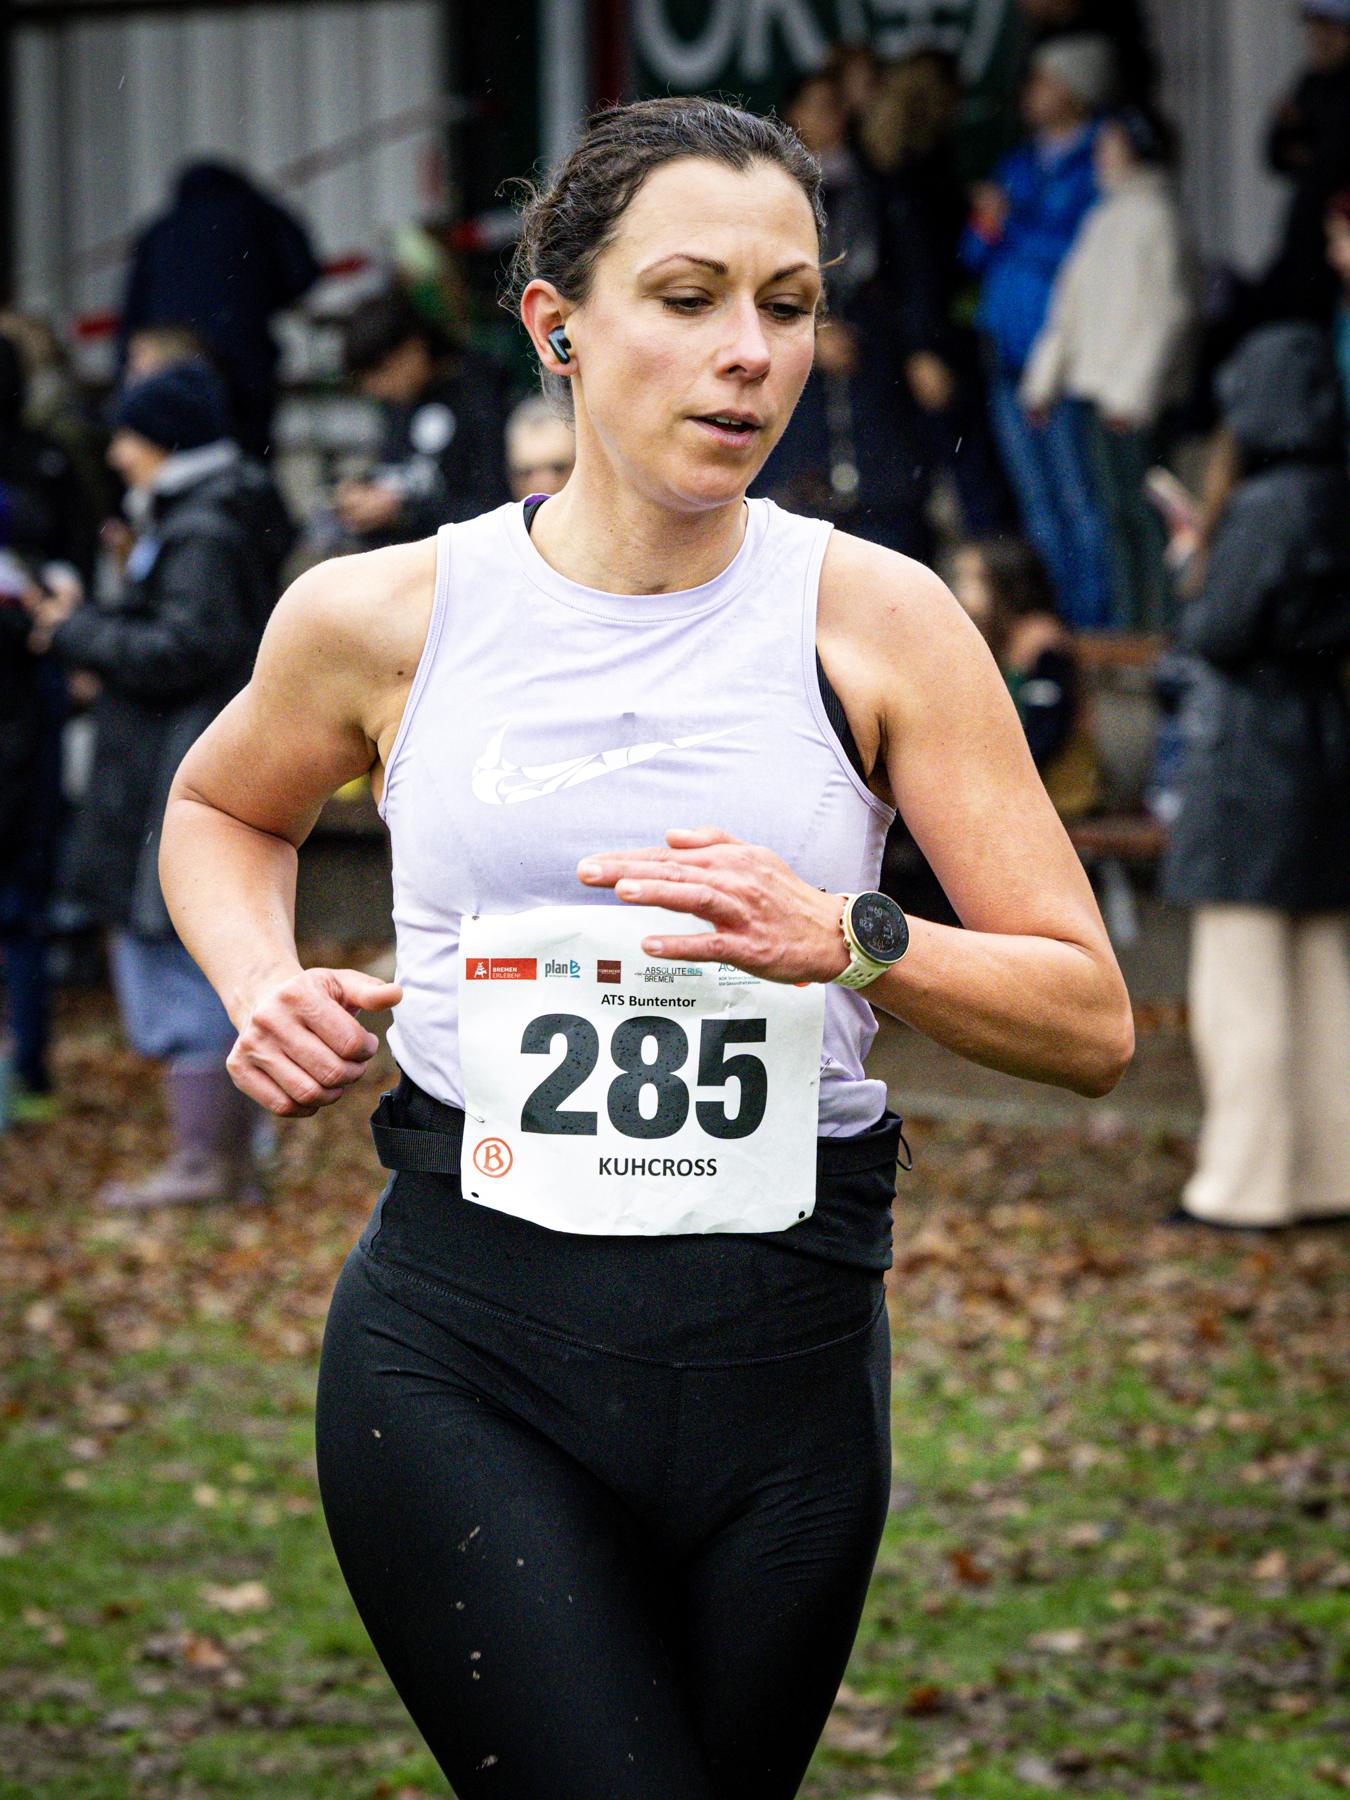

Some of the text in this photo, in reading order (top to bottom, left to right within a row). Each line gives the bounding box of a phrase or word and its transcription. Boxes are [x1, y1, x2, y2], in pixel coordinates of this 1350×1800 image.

[644, 975, 675, 984] BREMEN
[601, 994, 697, 1008] ATS Buntentor
[520, 1013, 768, 1140] 285
[598, 1157, 718, 1177] KUHCROSS
